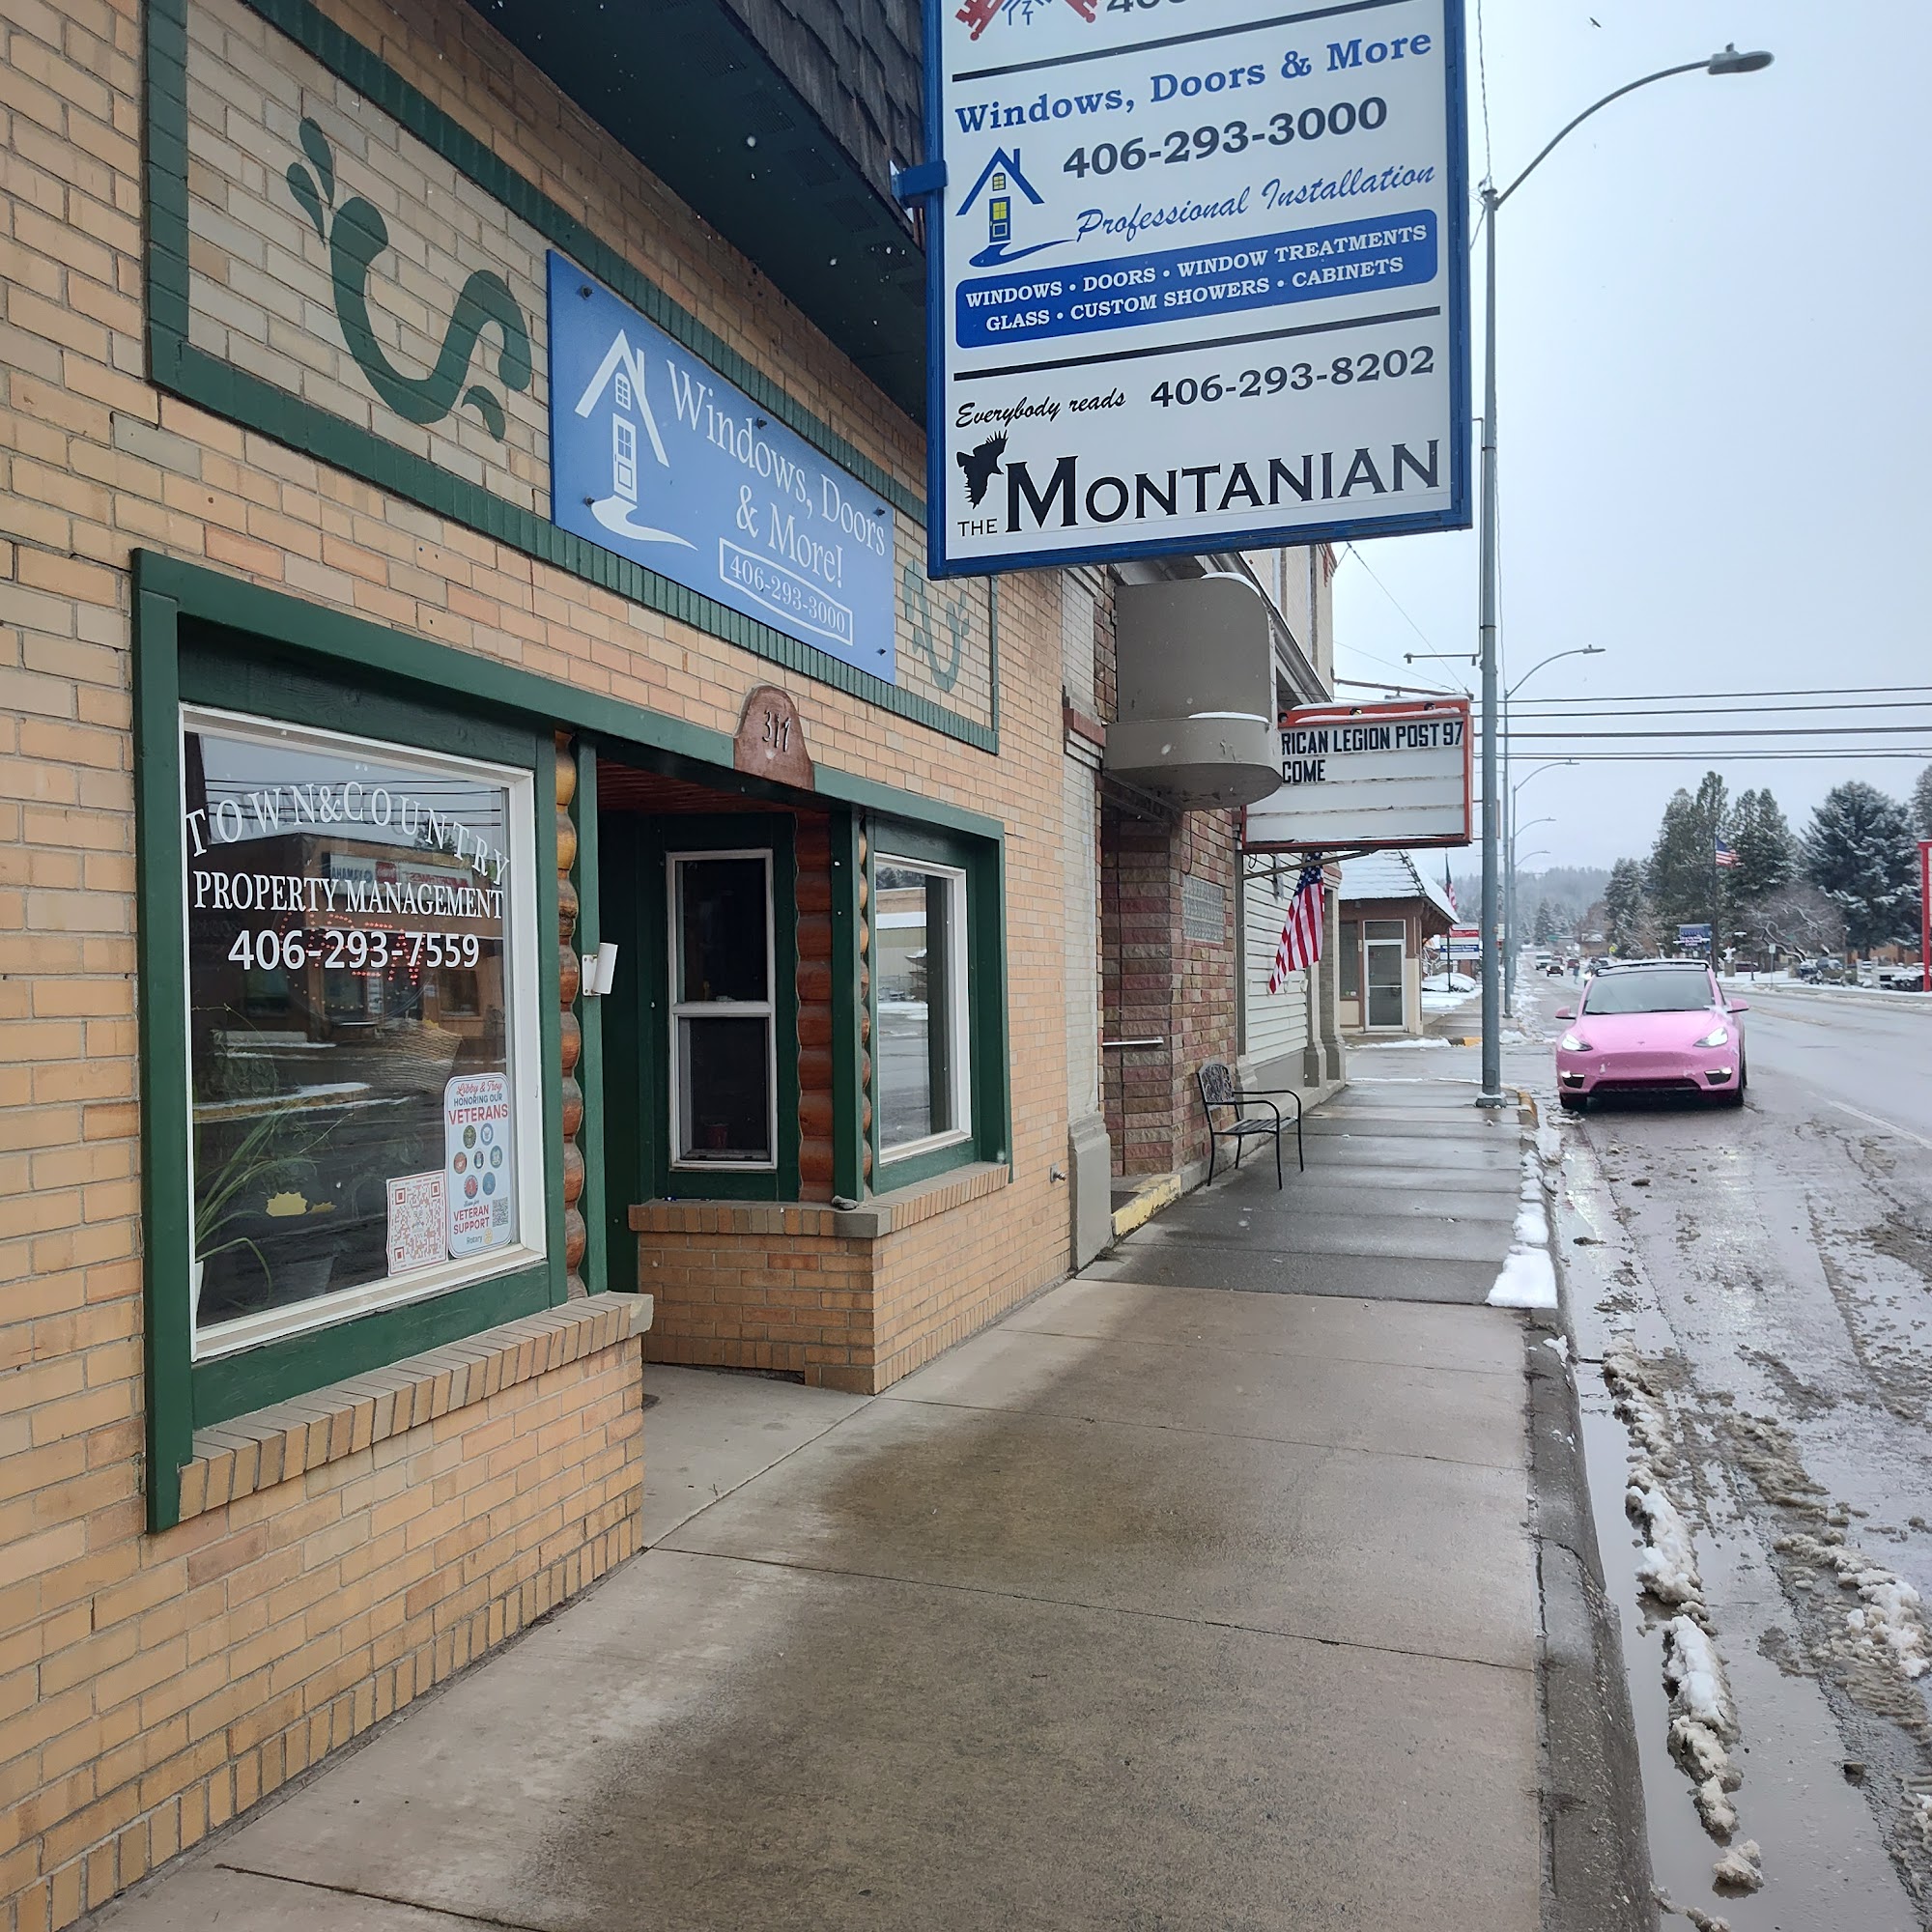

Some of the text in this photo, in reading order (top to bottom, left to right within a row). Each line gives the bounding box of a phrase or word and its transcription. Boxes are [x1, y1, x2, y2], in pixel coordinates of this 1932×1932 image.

[954, 33, 1433, 135] Windows, Doors & More
[1064, 96, 1388, 179] 406-293-3000
[1076, 163, 1435, 242] Professional Installation
[966, 224, 1428, 308] WINDOWS DOORS WINDOW TREATMENTS
[985, 257, 1404, 332] GLASS CUSTOM SHOWERS CABINETS
[954, 388, 1126, 429] Everybody reads
[1150, 345, 1435, 409] 406-293-8202
[666, 359, 886, 557] Windows, Doors
[957, 440, 1441, 537] THE MONTANIAN
[735, 484, 844, 588] & More!
[730, 554, 846, 634] 406-293-3000
[1281, 721, 1464, 756] RICAN LEGION POST 97
[1282, 759, 1326, 783] COME
[193, 870, 338, 913] PROPERTY
[345, 878, 505, 919] MANAGEMENT
[228, 929, 480, 971] 406-293-7559
[448, 1103, 508, 1124] VETERANS
[454, 1093, 502, 1107] HONORING OUR
[453, 1217, 490, 1235] SUPPORT
[454, 1205, 489, 1221] VETERAN
